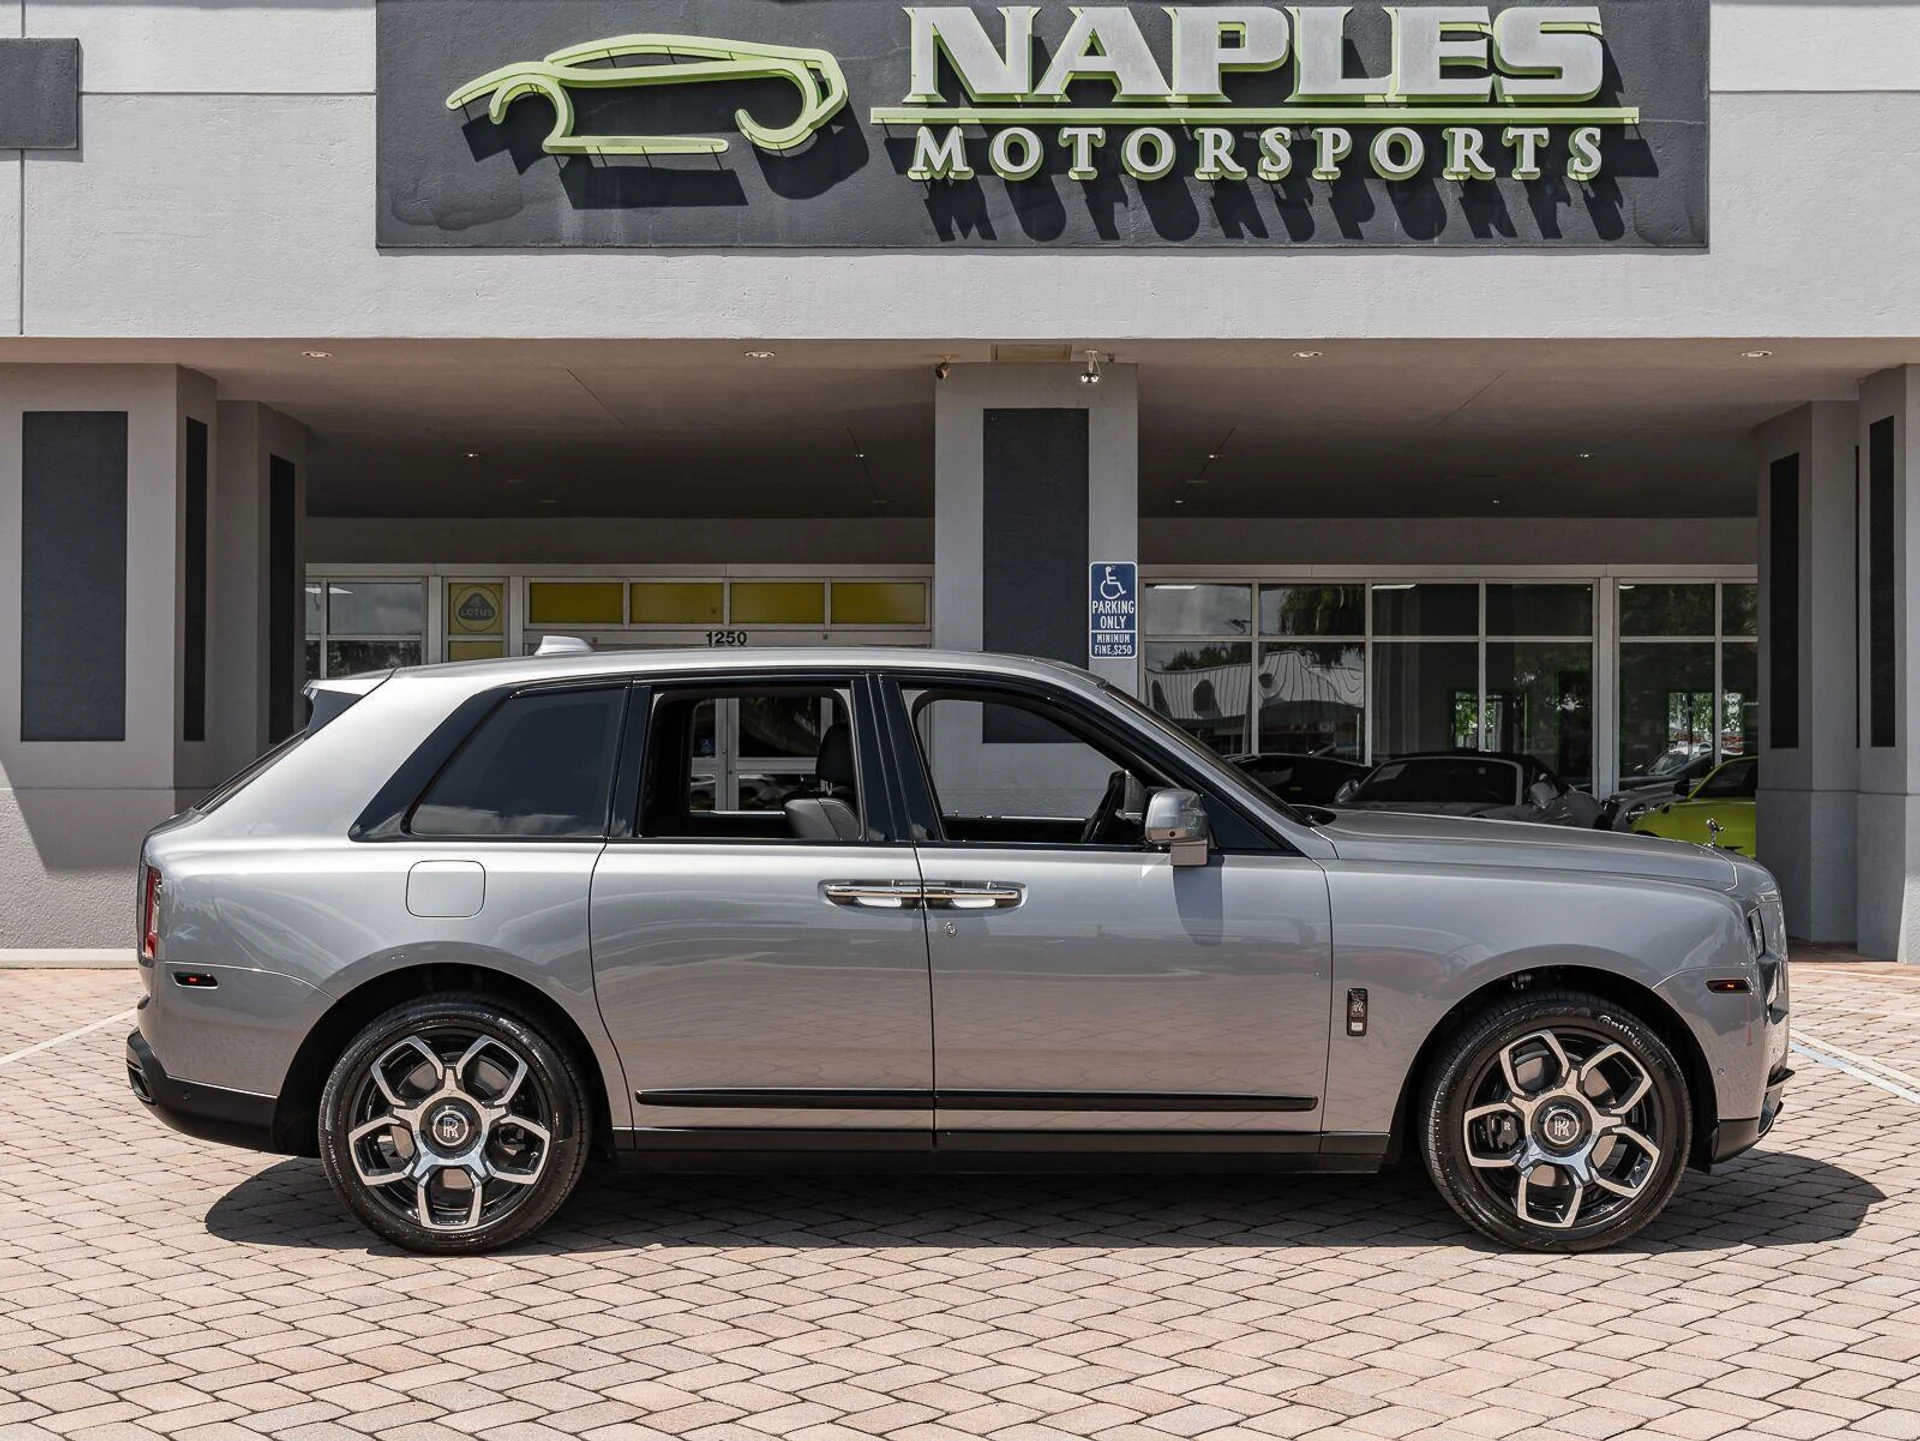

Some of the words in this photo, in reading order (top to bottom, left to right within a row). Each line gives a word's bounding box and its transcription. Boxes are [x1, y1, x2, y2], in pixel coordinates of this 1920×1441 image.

[903, 5, 1604, 104] NAPLES
[909, 126, 1603, 183] MOTORSPORTS
[460, 608, 494, 617] LOTUS
[1092, 601, 1134, 614] PARKING
[1100, 616, 1126, 629] ONLY
[706, 630, 747, 646] 1250
[1096, 633, 1130, 643] MINIMUM
[1114, 644, 1132, 655] $250
